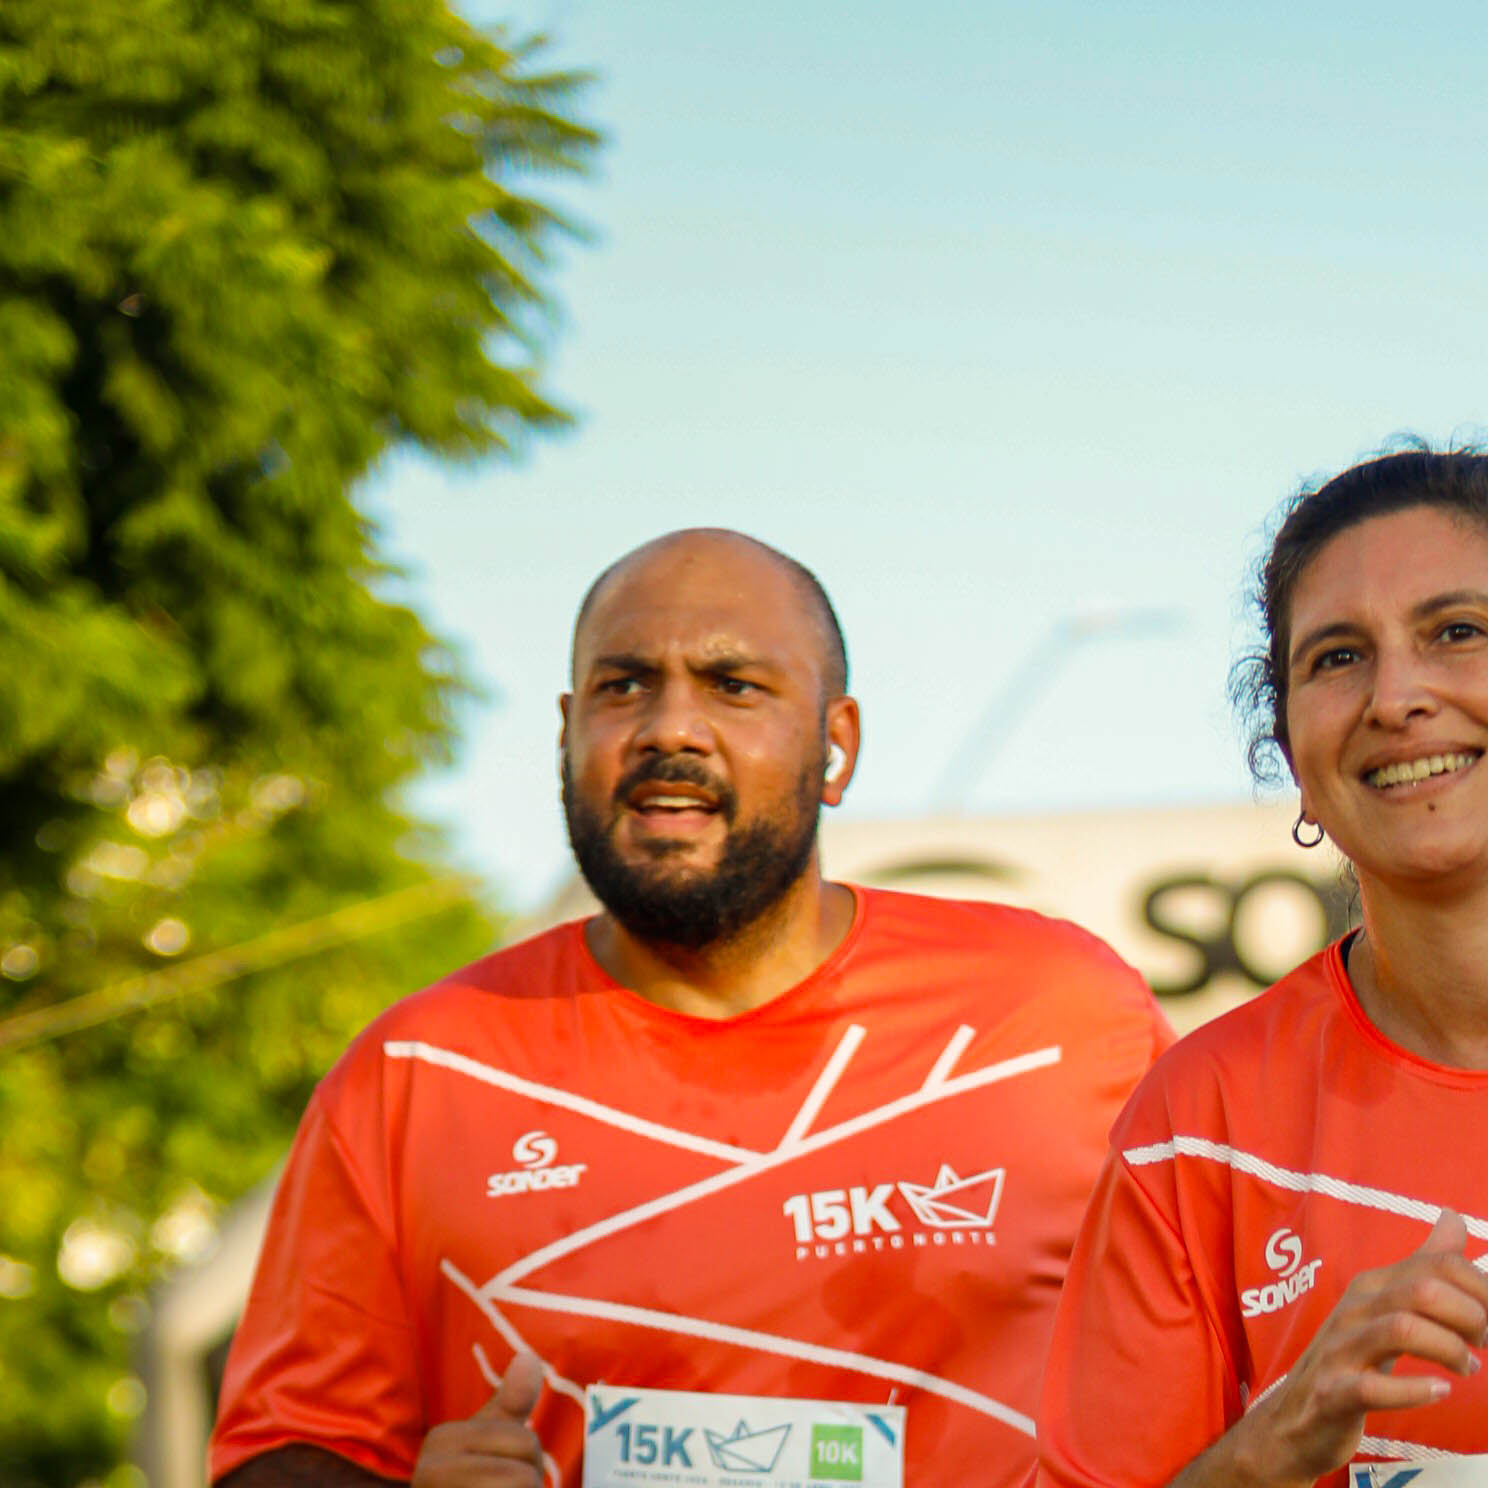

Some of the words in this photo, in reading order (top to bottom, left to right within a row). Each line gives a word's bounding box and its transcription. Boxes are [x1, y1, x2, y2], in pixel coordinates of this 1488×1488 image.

[783, 1184, 901, 1243] 15K
[796, 1234, 904, 1261] PUERTO
[913, 1231, 996, 1247] NORTE
[615, 1420, 695, 1469] 15K
[815, 1440, 860, 1466] 10K
